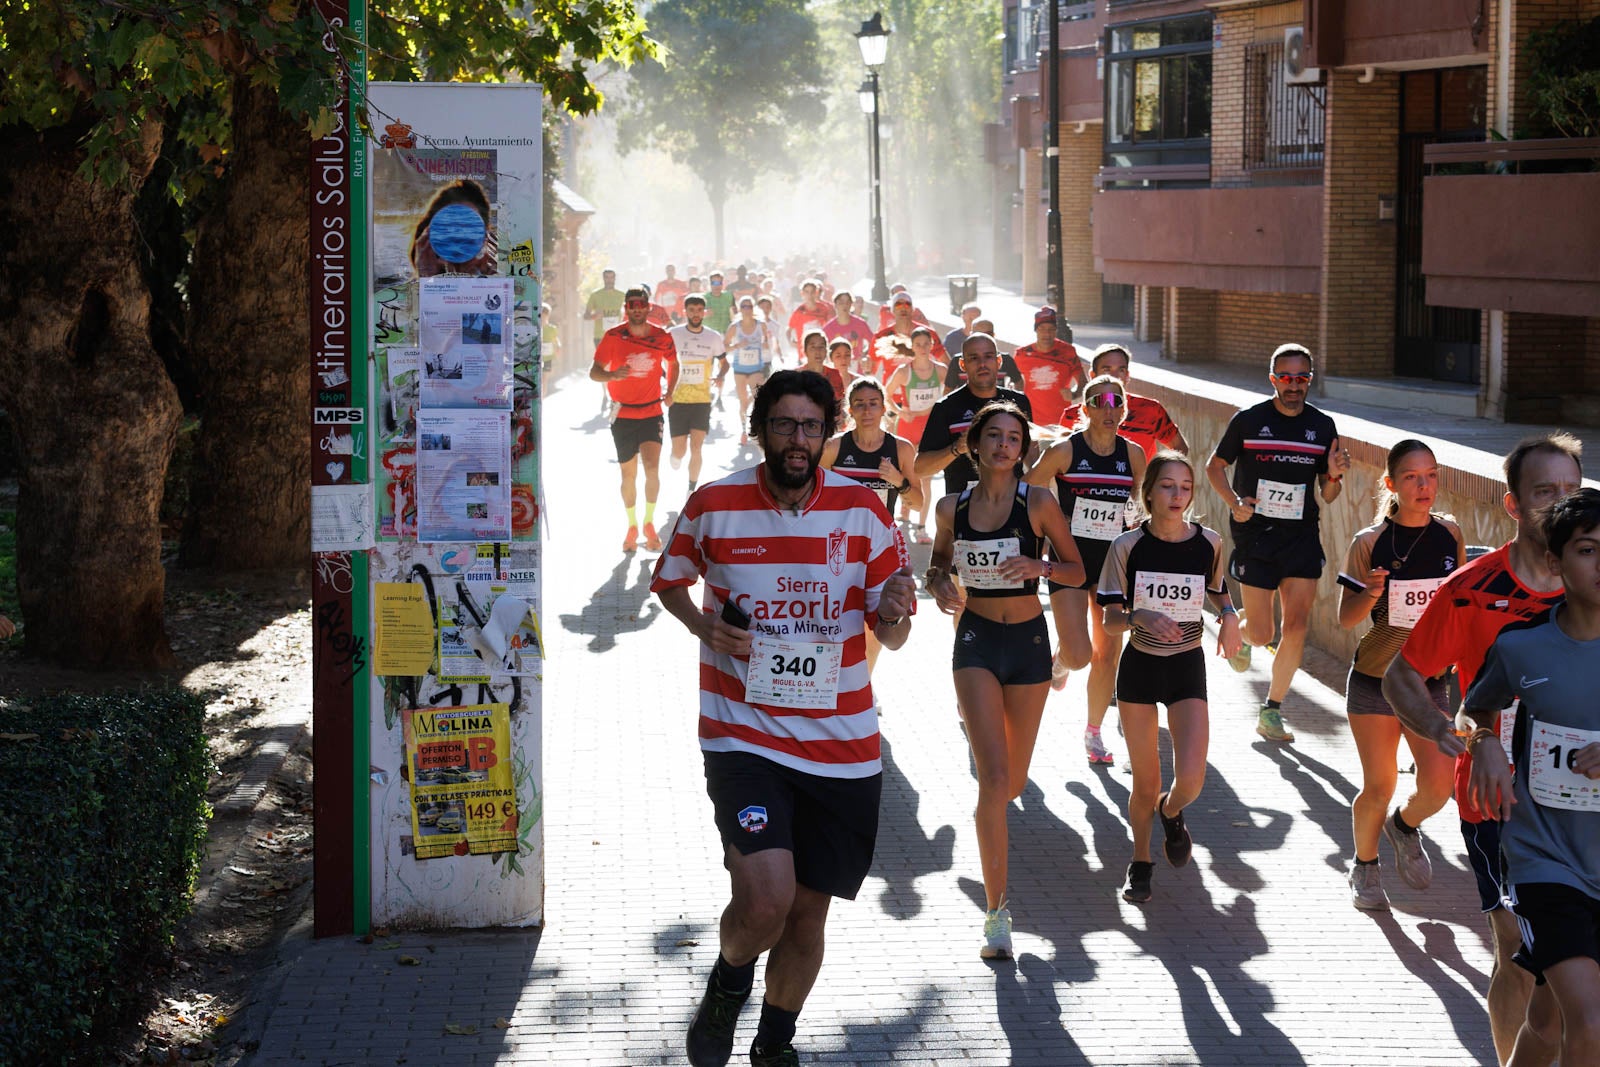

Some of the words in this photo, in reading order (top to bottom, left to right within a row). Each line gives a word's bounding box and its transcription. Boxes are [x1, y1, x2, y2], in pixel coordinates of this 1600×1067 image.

[353, 81, 363, 95] de
[424, 135, 460, 146] Excmo.
[463, 135, 533, 148] Ayuntamiento
[353, 150, 363, 177] Ruta
[317, 410, 362, 422] MPS
[1268, 489, 1293, 503] 774
[1082, 508, 1116, 522] 1014
[967, 551, 1000, 566] 837
[777, 576, 829, 593] Sierra
[1146, 583, 1192, 600] 1039
[756, 622, 789, 635] Agua
[770, 654, 816, 677] 340
[772, 678, 795, 687] MIGUEL
[435, 711, 492, 719] AUTOESCUELAS
[422, 755, 461, 765] PERMISO
[415, 795, 428, 803] CON
[440, 792, 468, 801] CLASES
[467, 802, 496, 820] 149
[501, 801, 514, 818] €
